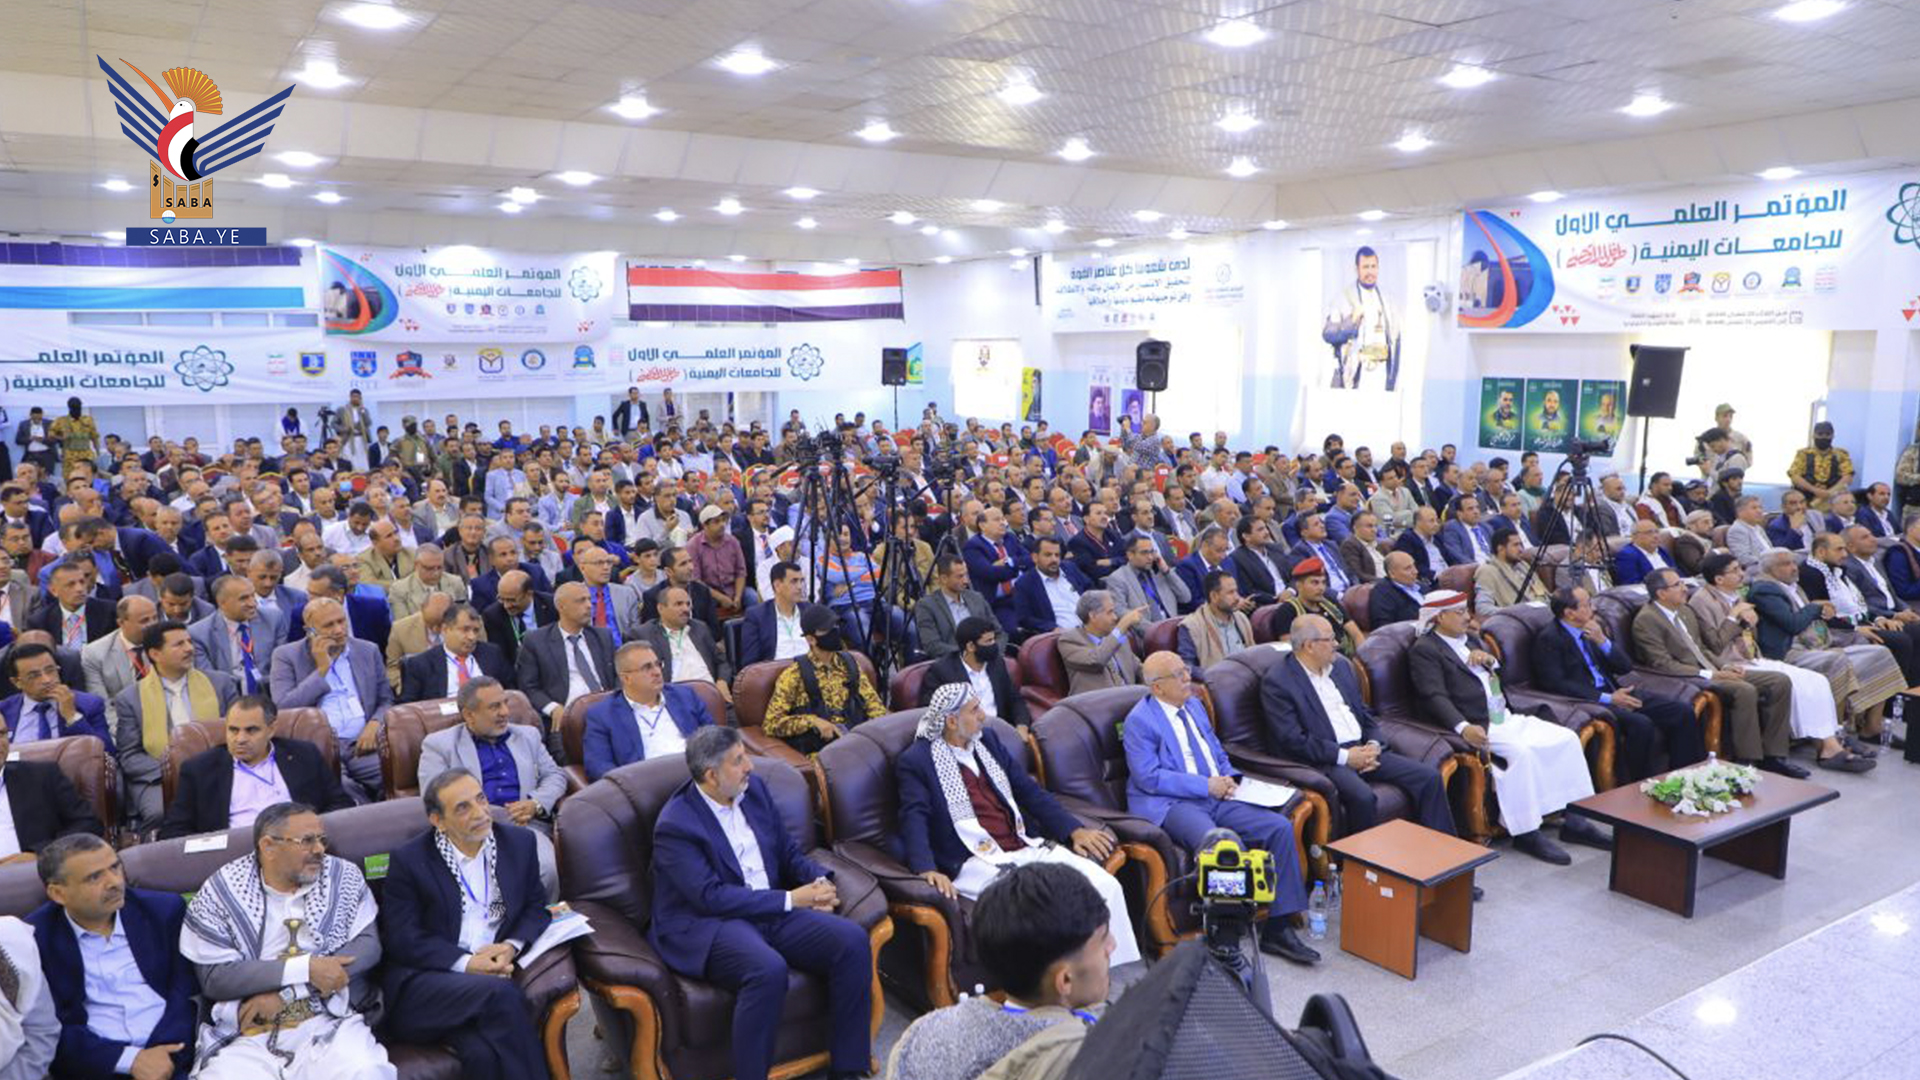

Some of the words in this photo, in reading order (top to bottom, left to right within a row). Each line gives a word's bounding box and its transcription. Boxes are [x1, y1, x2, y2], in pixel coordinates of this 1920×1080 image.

[1605, 200, 1727, 233] العلمي
[1734, 189, 1847, 224] المؤتمر
[1640, 238, 1709, 263] اليمنية
[1714, 228, 1843, 256] للجامعات
[12, 374, 75, 391] اليمنية
[79, 374, 166, 391] للجامعات
